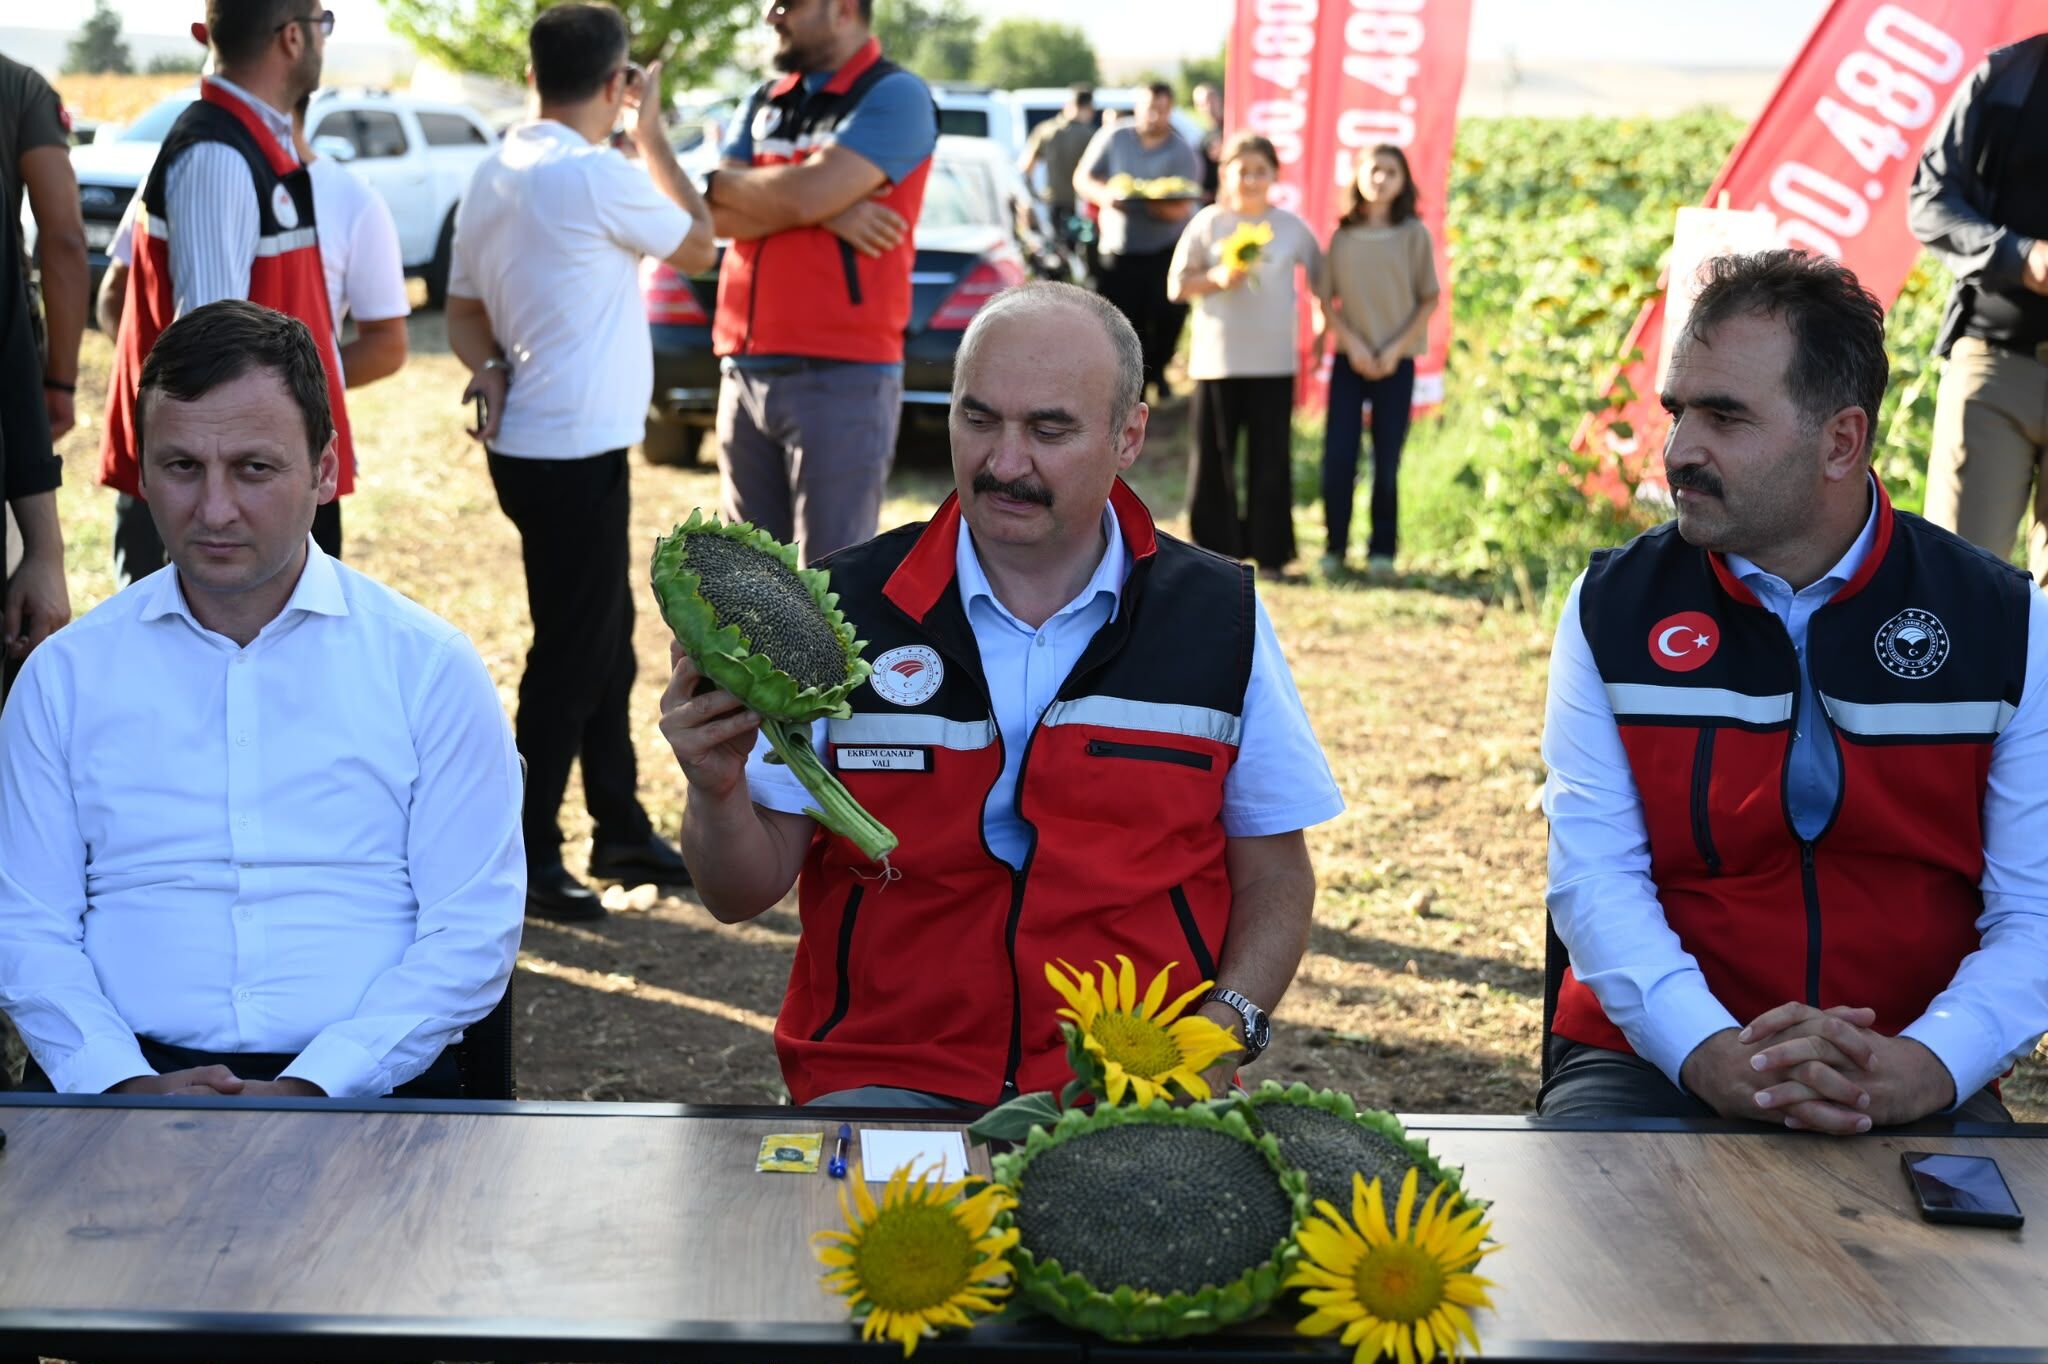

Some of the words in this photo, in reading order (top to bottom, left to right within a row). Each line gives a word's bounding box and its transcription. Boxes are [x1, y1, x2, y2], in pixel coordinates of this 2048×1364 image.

[847, 749, 878, 757] EKREM
[880, 749, 914, 757] CANALP
[872, 759, 890, 767] VALİ
